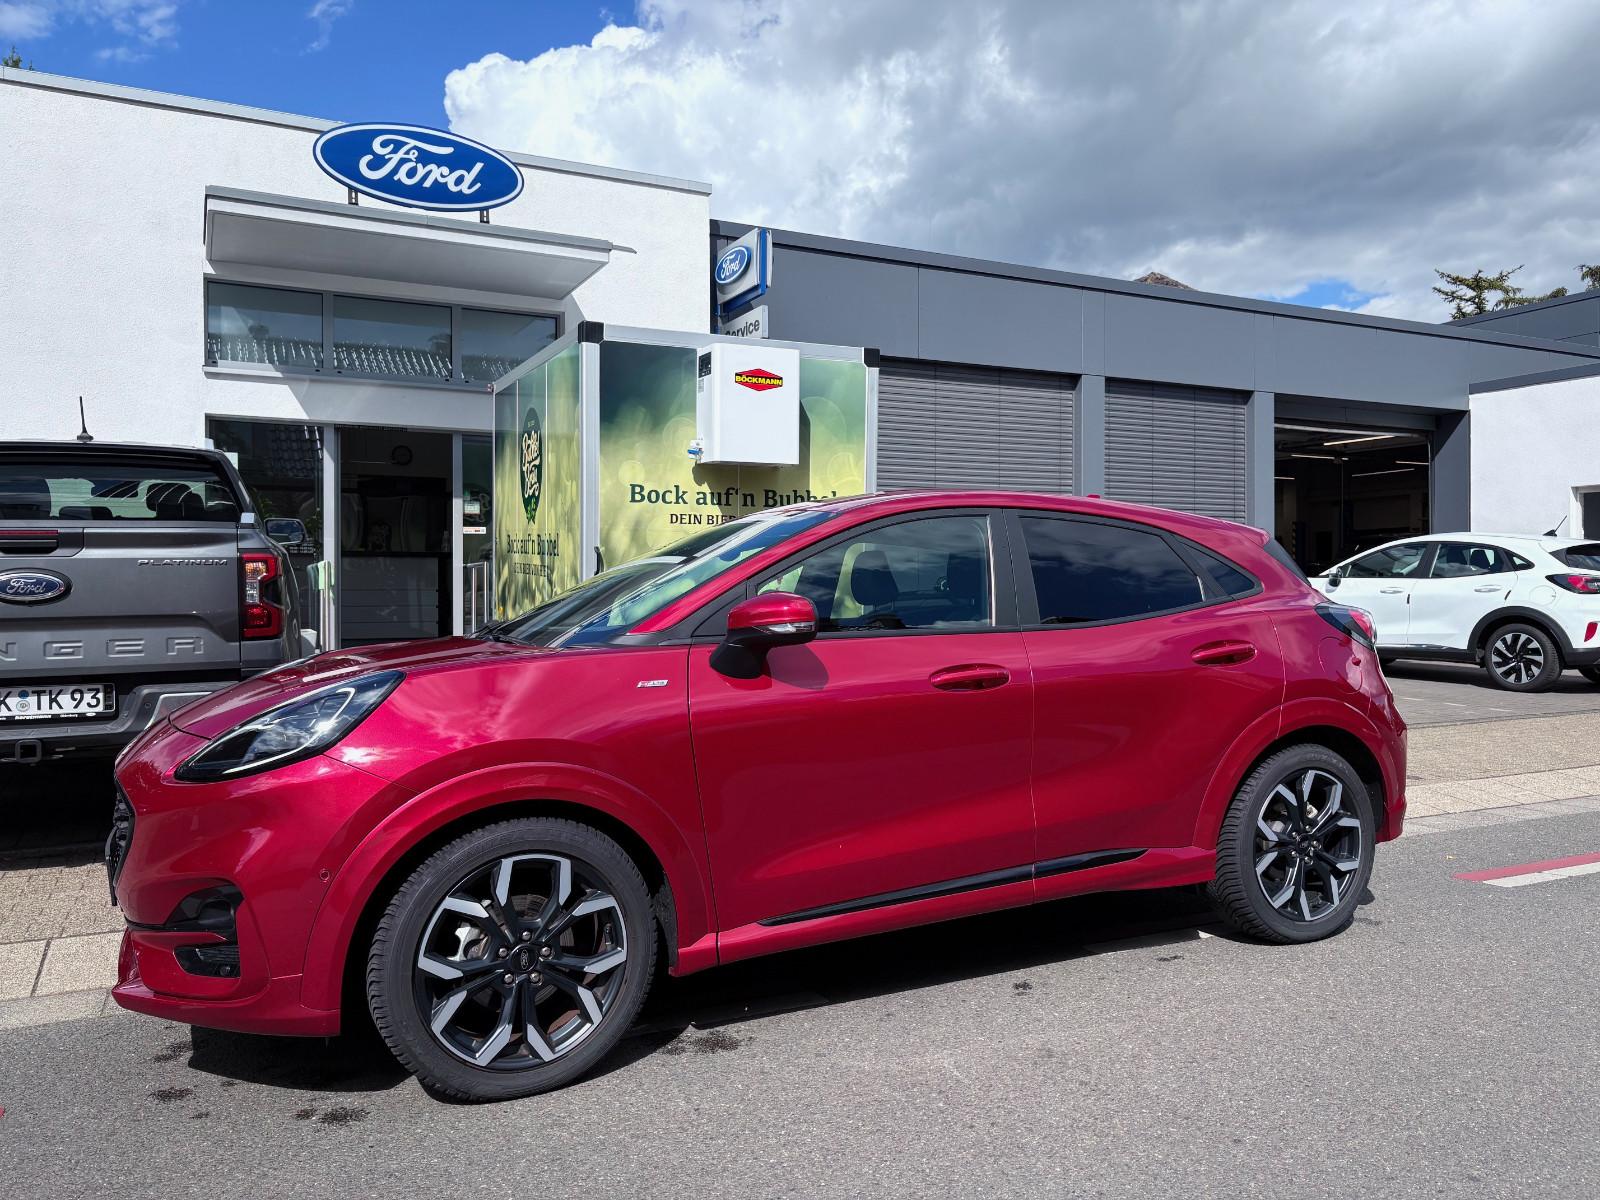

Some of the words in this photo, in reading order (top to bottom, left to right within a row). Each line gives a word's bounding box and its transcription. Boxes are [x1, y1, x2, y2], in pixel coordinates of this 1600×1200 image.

[358, 134, 485, 195] Ford
[720, 253, 741, 279] Ford
[735, 374, 783, 386] BÖCKMANN
[629, 483, 689, 505] Bock
[763, 489, 837, 508] Bubb
[669, 513, 703, 525] DEIN
[137, 559, 229, 567] PLATINUM
[6, 578, 46, 595] Ford
[31, 688, 64, 711] TK
[70, 687, 101, 710] 93
